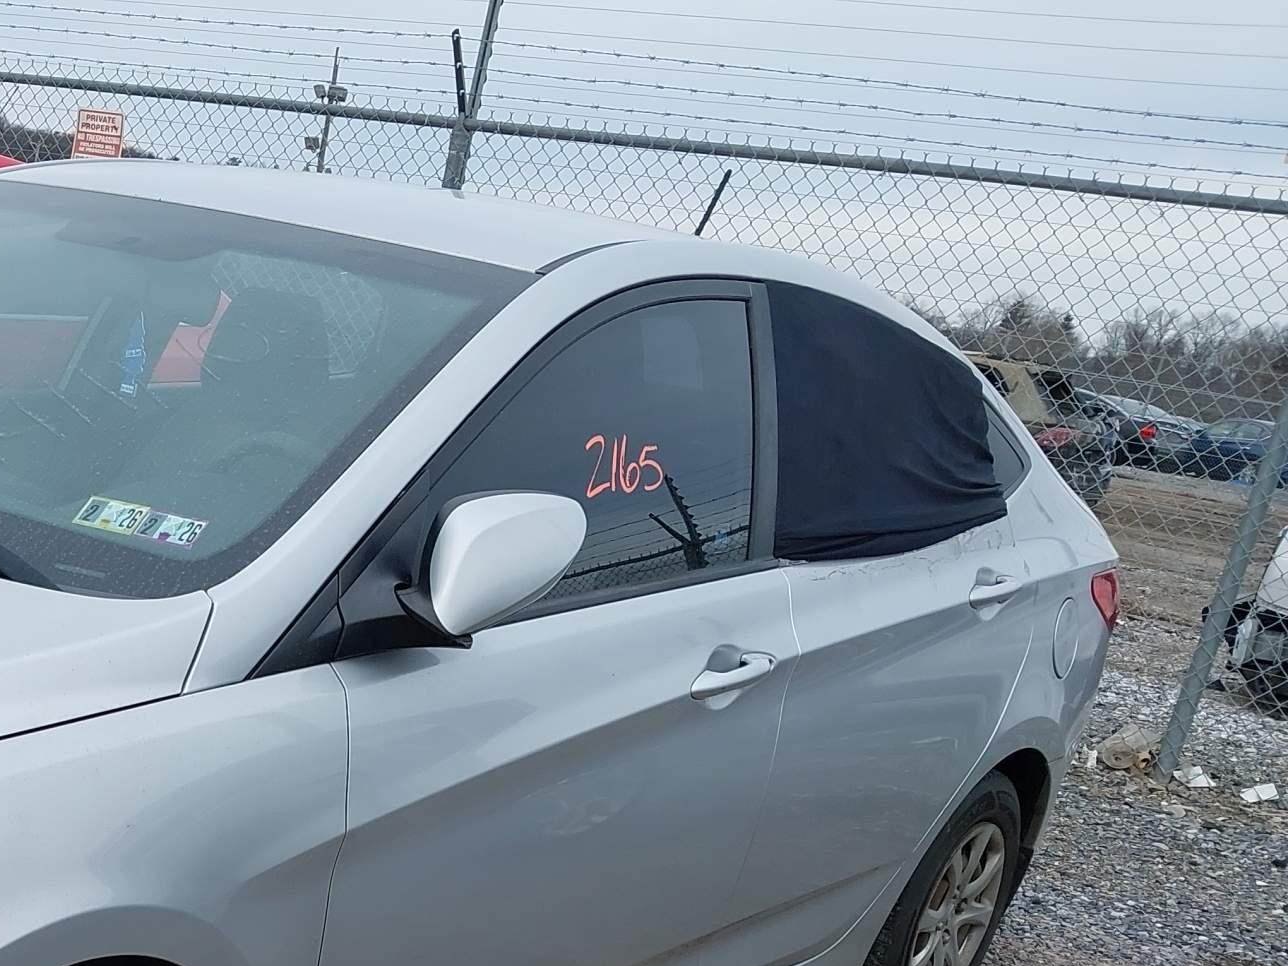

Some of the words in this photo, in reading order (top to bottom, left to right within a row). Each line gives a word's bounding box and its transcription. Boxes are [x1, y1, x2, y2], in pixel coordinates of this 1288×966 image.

[81, 122, 119, 133] PROPERTY
[86, 114, 116, 124] PRIVATE
[585, 434, 664, 498] 2165
[81, 504, 100, 521] 2
[118, 508, 143, 529] 26
[140, 518, 158, 535] 2
[178, 521, 202, 543] 26
